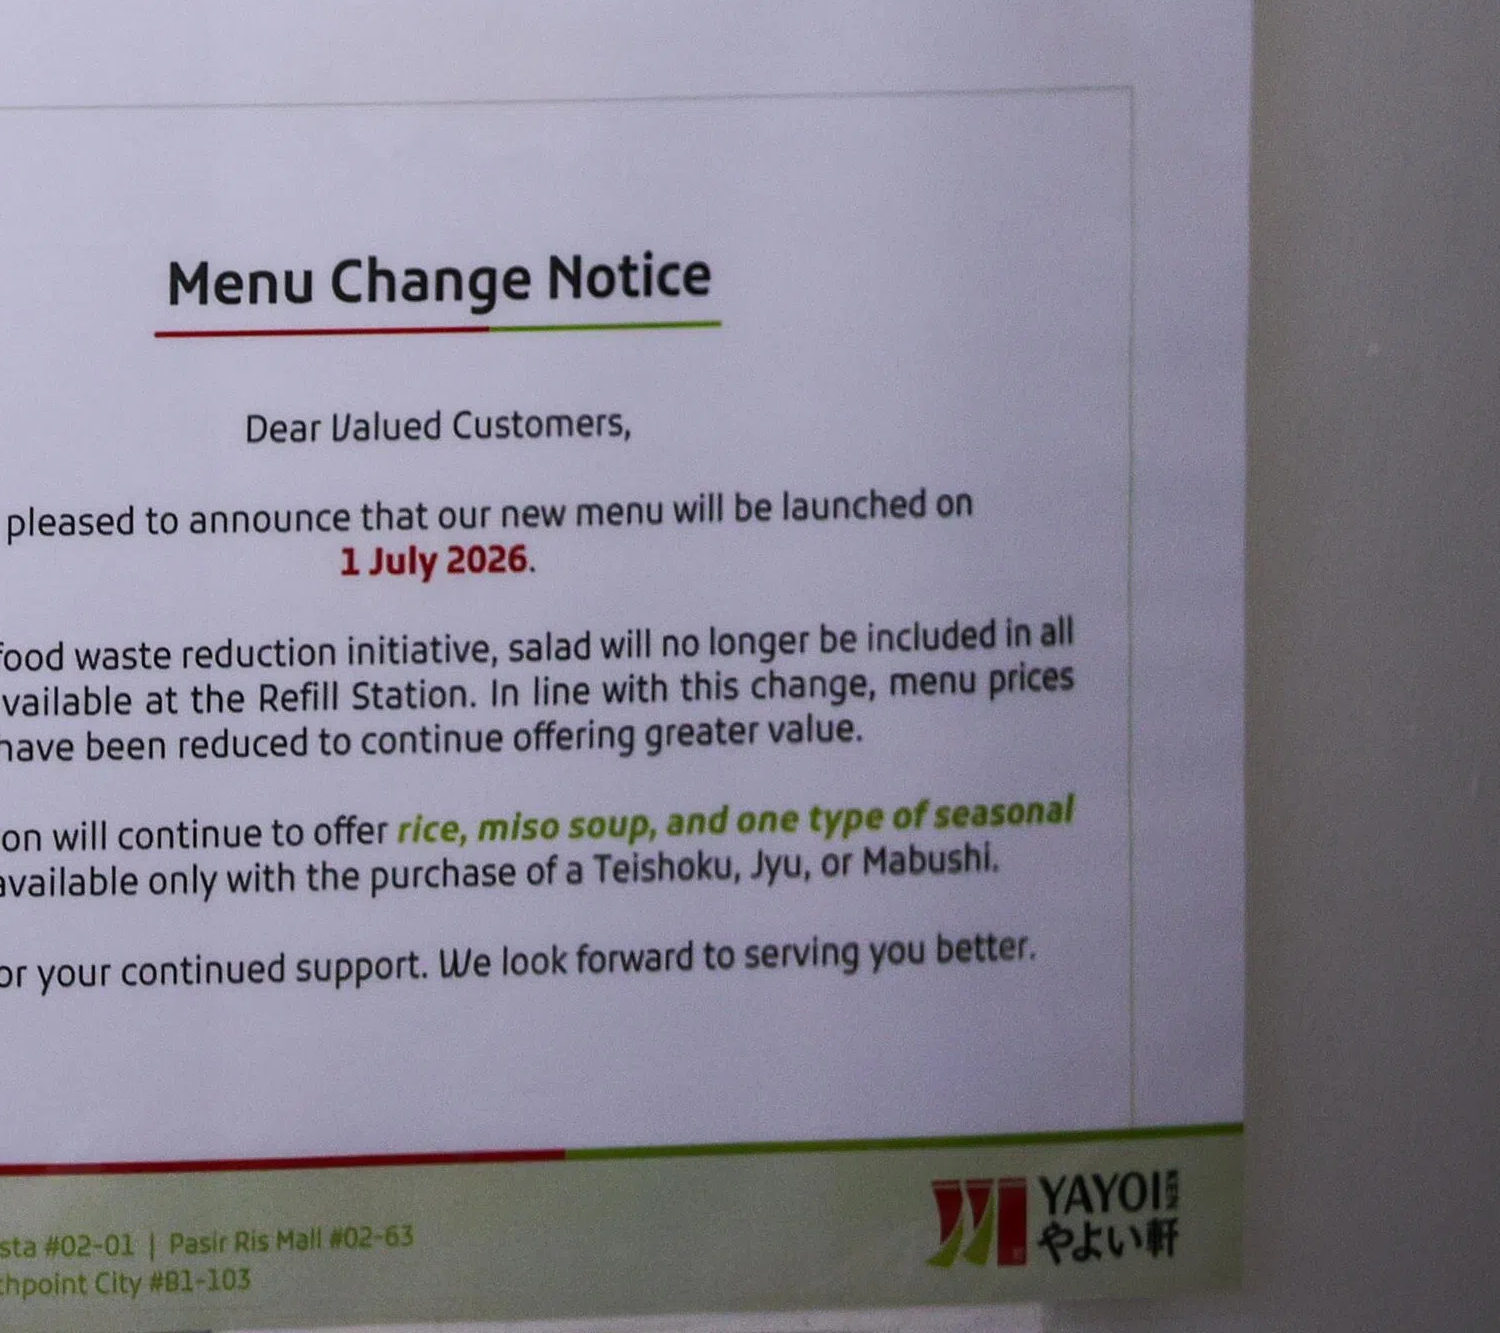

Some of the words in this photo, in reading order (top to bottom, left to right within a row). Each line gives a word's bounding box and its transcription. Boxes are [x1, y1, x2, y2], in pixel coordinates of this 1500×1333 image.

[170, 261, 312, 305] Menu
[332, 256, 531, 315] Change
[550, 251, 711, 299] Notice
[247, 414, 321, 443] Dear
[332, 410, 441, 442] Valued
[453, 410, 631, 441] Customers,
[7, 505, 134, 545] pleased
[146, 507, 178, 535] to
[189, 509, 351, 534] announce
[361, 501, 428, 531] that
[438, 506, 491, 529] our
[502, 505, 566, 528] new
[577, 502, 663, 526] menu
[673, 493, 723, 523] will
[735, 492, 772, 522] be
[783, 488, 926, 521] launched
[936, 493, 972, 518] on
[341, 547, 360, 576] 1
[369, 545, 438, 583] July
[447, 544, 534, 574] 2026.
[75, 642, 171, 670] waste
[183, 637, 336, 669] reduction
[348, 634, 498, 667] initiative,
[509, 630, 591, 662] salad
[600, 628, 651, 659] will
[663, 634, 700, 657] no
[710, 626, 809, 664] longer
[820, 624, 857, 653] be
[868, 619, 996, 652] included
[1007, 618, 1031, 647] in
[1041, 616, 1073, 647] all
[53, 820, 106, 851] will
[118, 818, 262, 851] continue
[272, 820, 304, 847] to
[314, 814, 388, 846] offer
[398, 815, 467, 846] rice,
[478, 812, 560, 841] miso
[569, 815, 656, 845] soup,
[667, 805, 729, 836] and
[737, 811, 799, 833] one
[810, 806, 884, 839] type
[893, 800, 929, 829] of
[935, 794, 1074, 829] seasonal
[1038, 1170, 1160, 1215] YAYOI
[45, 1234, 135, 1258] #02-01
[169, 1230, 226, 1255] Pasir
[234, 1230, 269, 1253] Ris
[276, 1226, 322, 1251] Mall
[329, 1224, 415, 1249] #02-63
[1037, 1216, 1179, 1266] やよい軒
[95, 1271, 142, 1300] City
[149, 1267, 251, 1293] #B1-103
